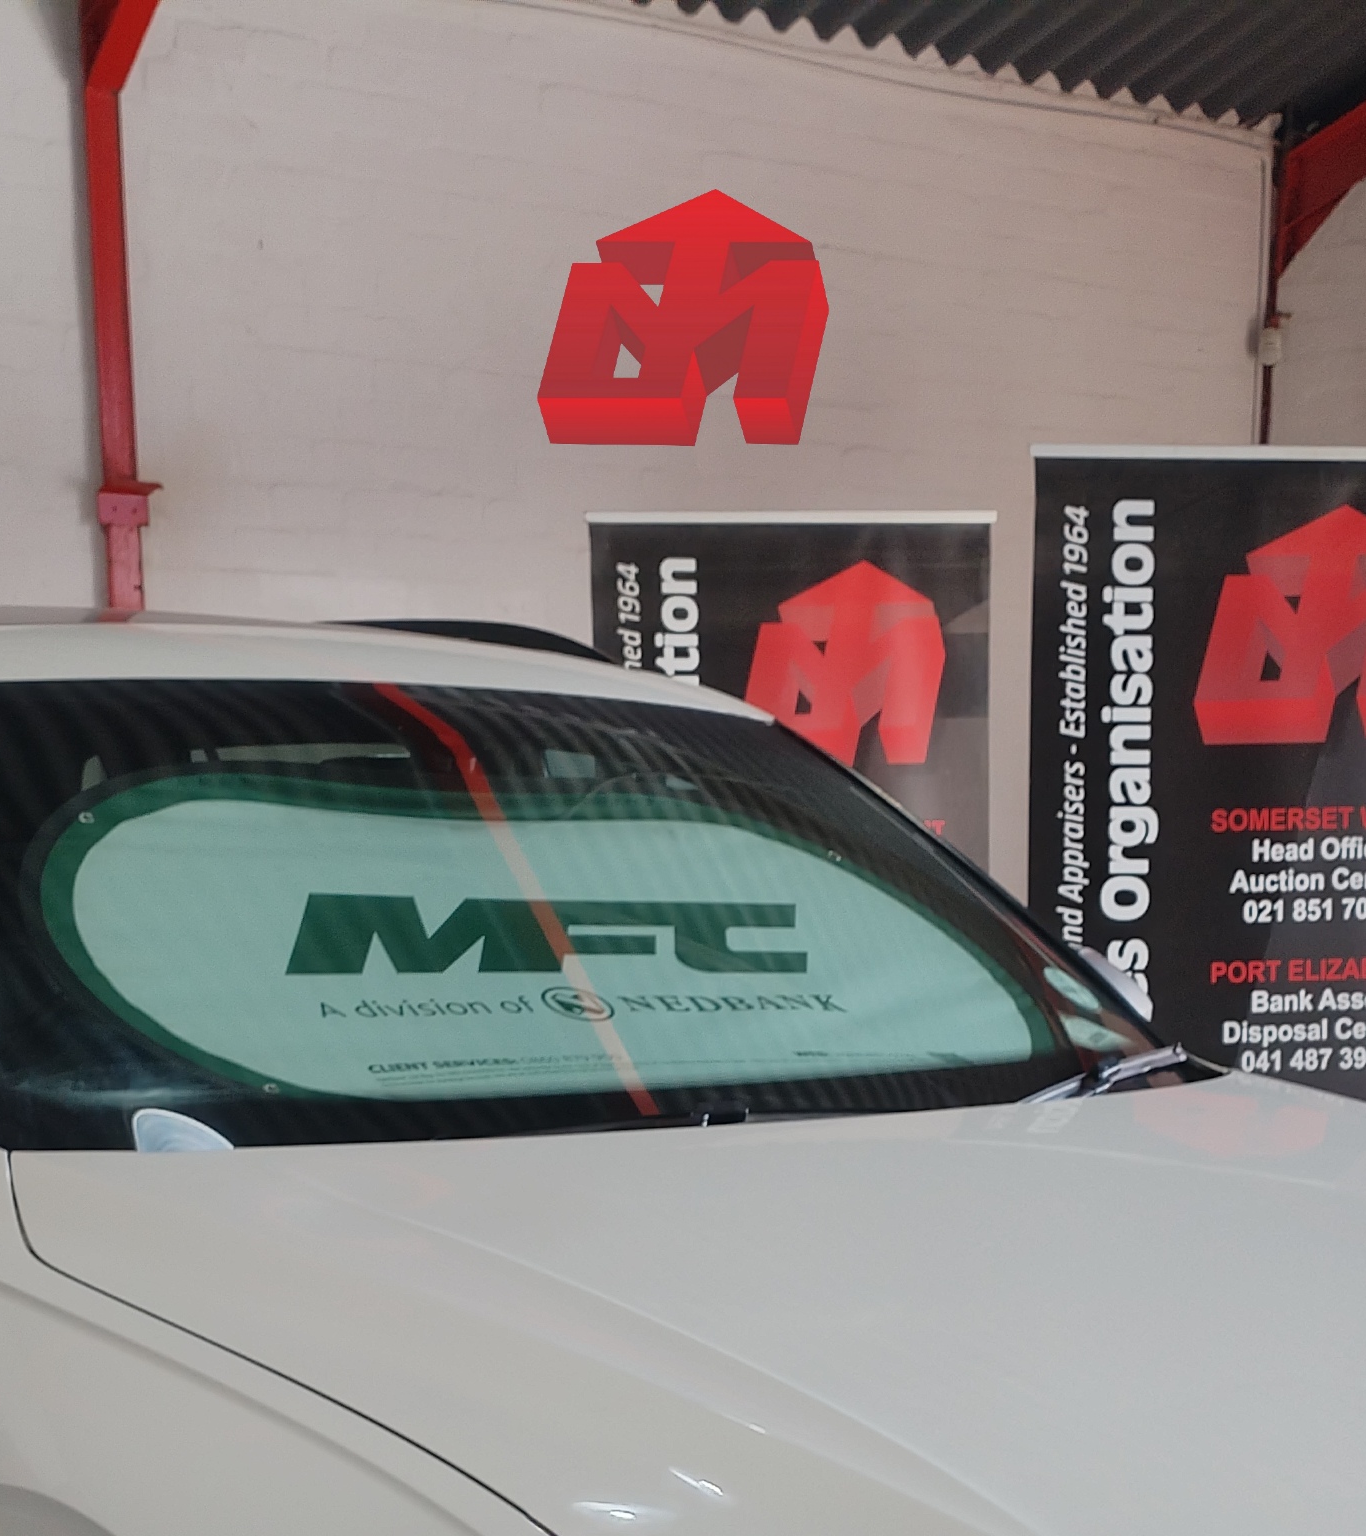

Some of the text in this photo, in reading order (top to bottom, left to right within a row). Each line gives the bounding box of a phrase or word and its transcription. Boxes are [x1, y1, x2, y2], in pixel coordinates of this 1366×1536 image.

[1062, 504, 1090, 575] 1964
[615, 561, 641, 624] 1964
[1058, 580, 1088, 739] Established
[1099, 498, 1160, 922] Organisation
[1056, 760, 1090, 903] Appraisers
[1210, 805, 1355, 833] SOMERSET
[1251, 837, 1314, 863] Head
[1228, 868, 1325, 894] Auction
[1242, 898, 1284, 924] 021
[1291, 897, 1334, 922] 851
[285, 893, 807, 975] MFC
[1210, 959, 1281, 985] PORT
[319, 994, 849, 1019] A division of NEDBANK
[1251, 988, 1314, 1014] Bank
[1221, 1017, 1329, 1047] Disposal
[1240, 1049, 1283, 1073] 041
[1289, 1047, 1334, 1072] 487
